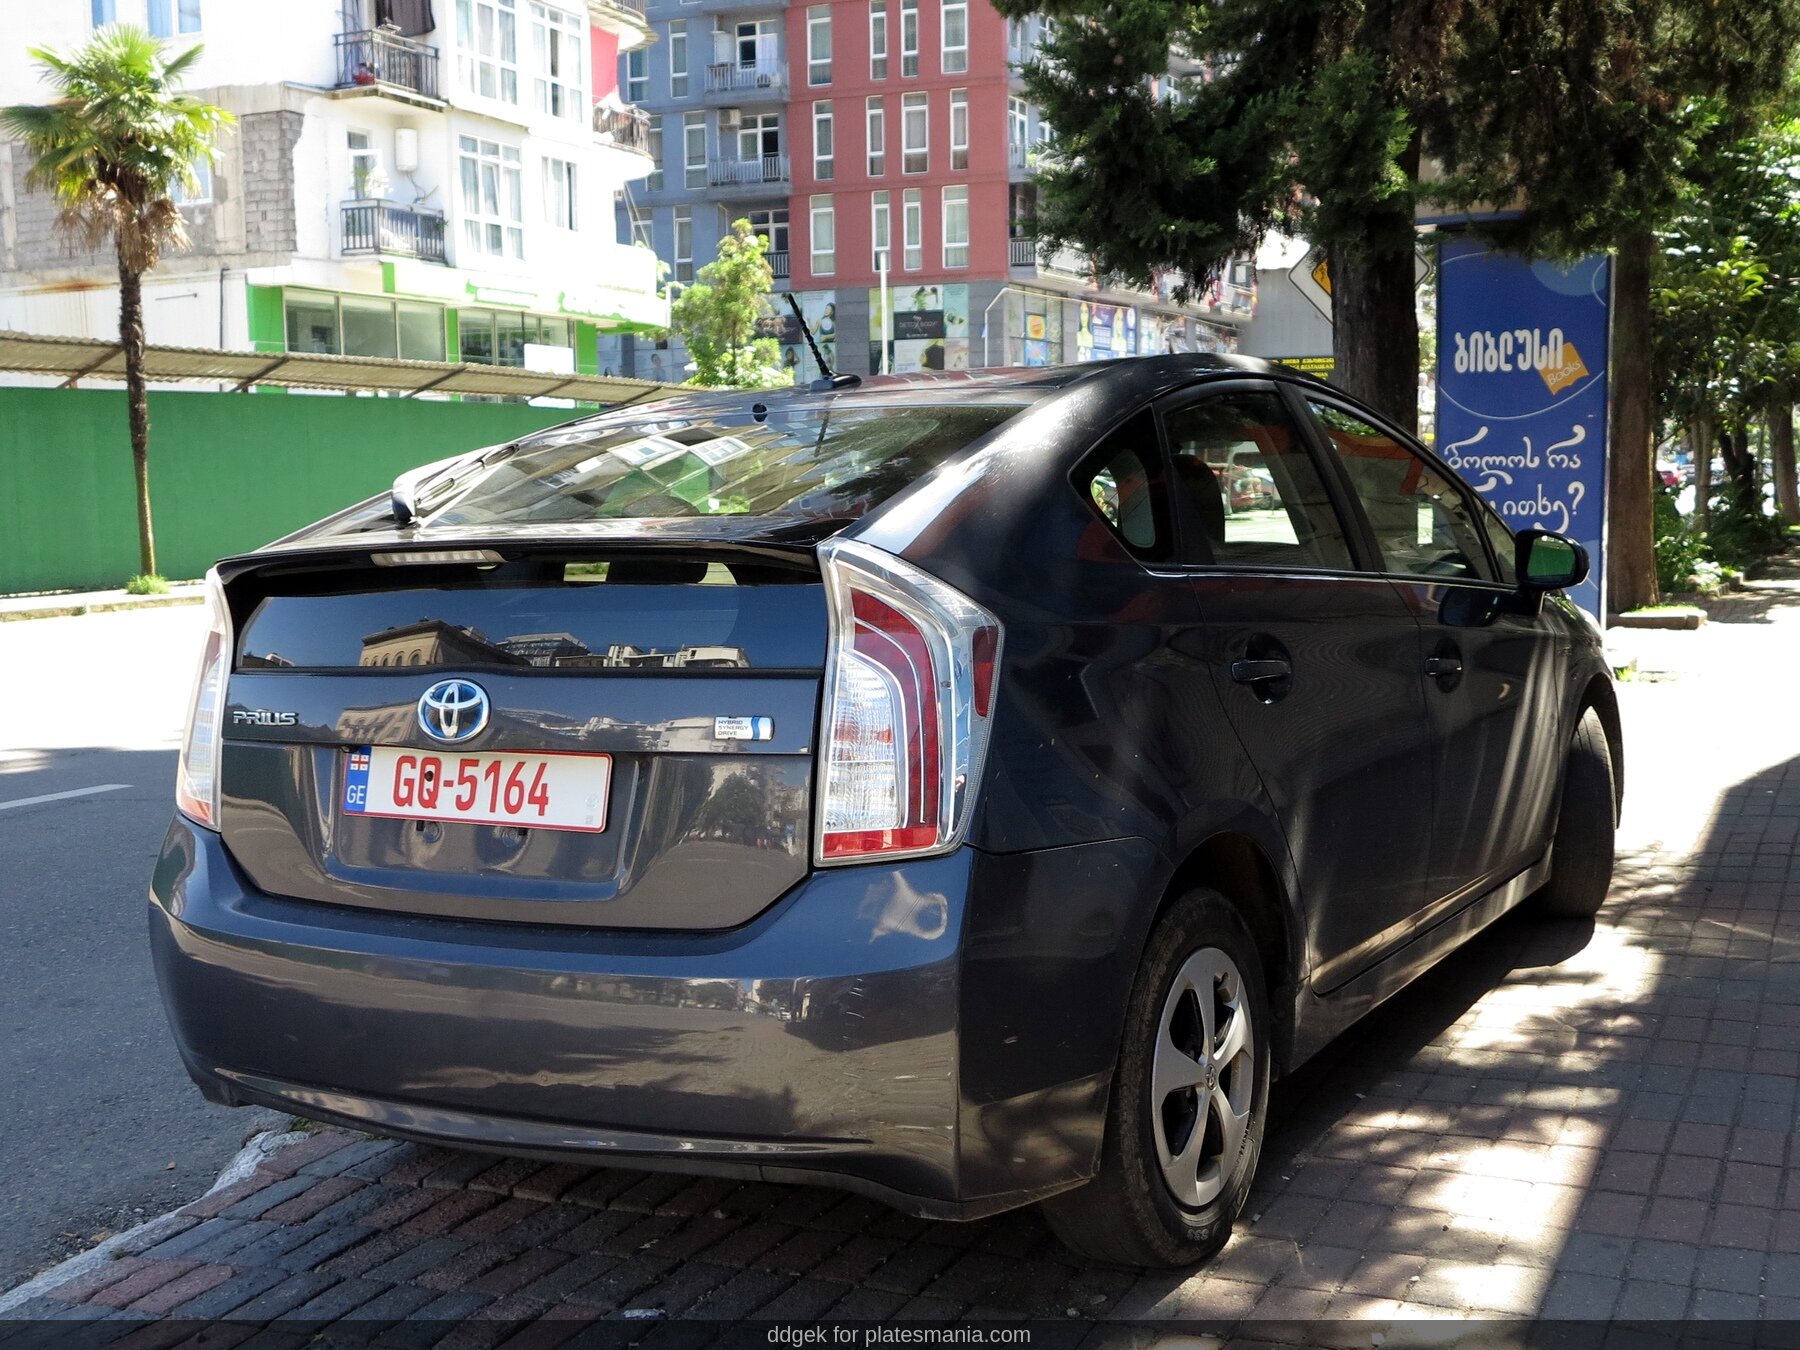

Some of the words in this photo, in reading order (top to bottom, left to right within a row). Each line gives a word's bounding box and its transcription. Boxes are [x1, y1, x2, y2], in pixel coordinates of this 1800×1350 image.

[1455, 328, 1564, 373] ბიბლუსი
[1547, 360, 1582, 385] Books
[1444, 426, 1540, 485] ბოლოს
[1546, 424, 1586, 468] რა
[233, 710, 297, 726] PRIUS
[346, 785, 366, 805] GE
[393, 755, 549, 816] GQ-5164
